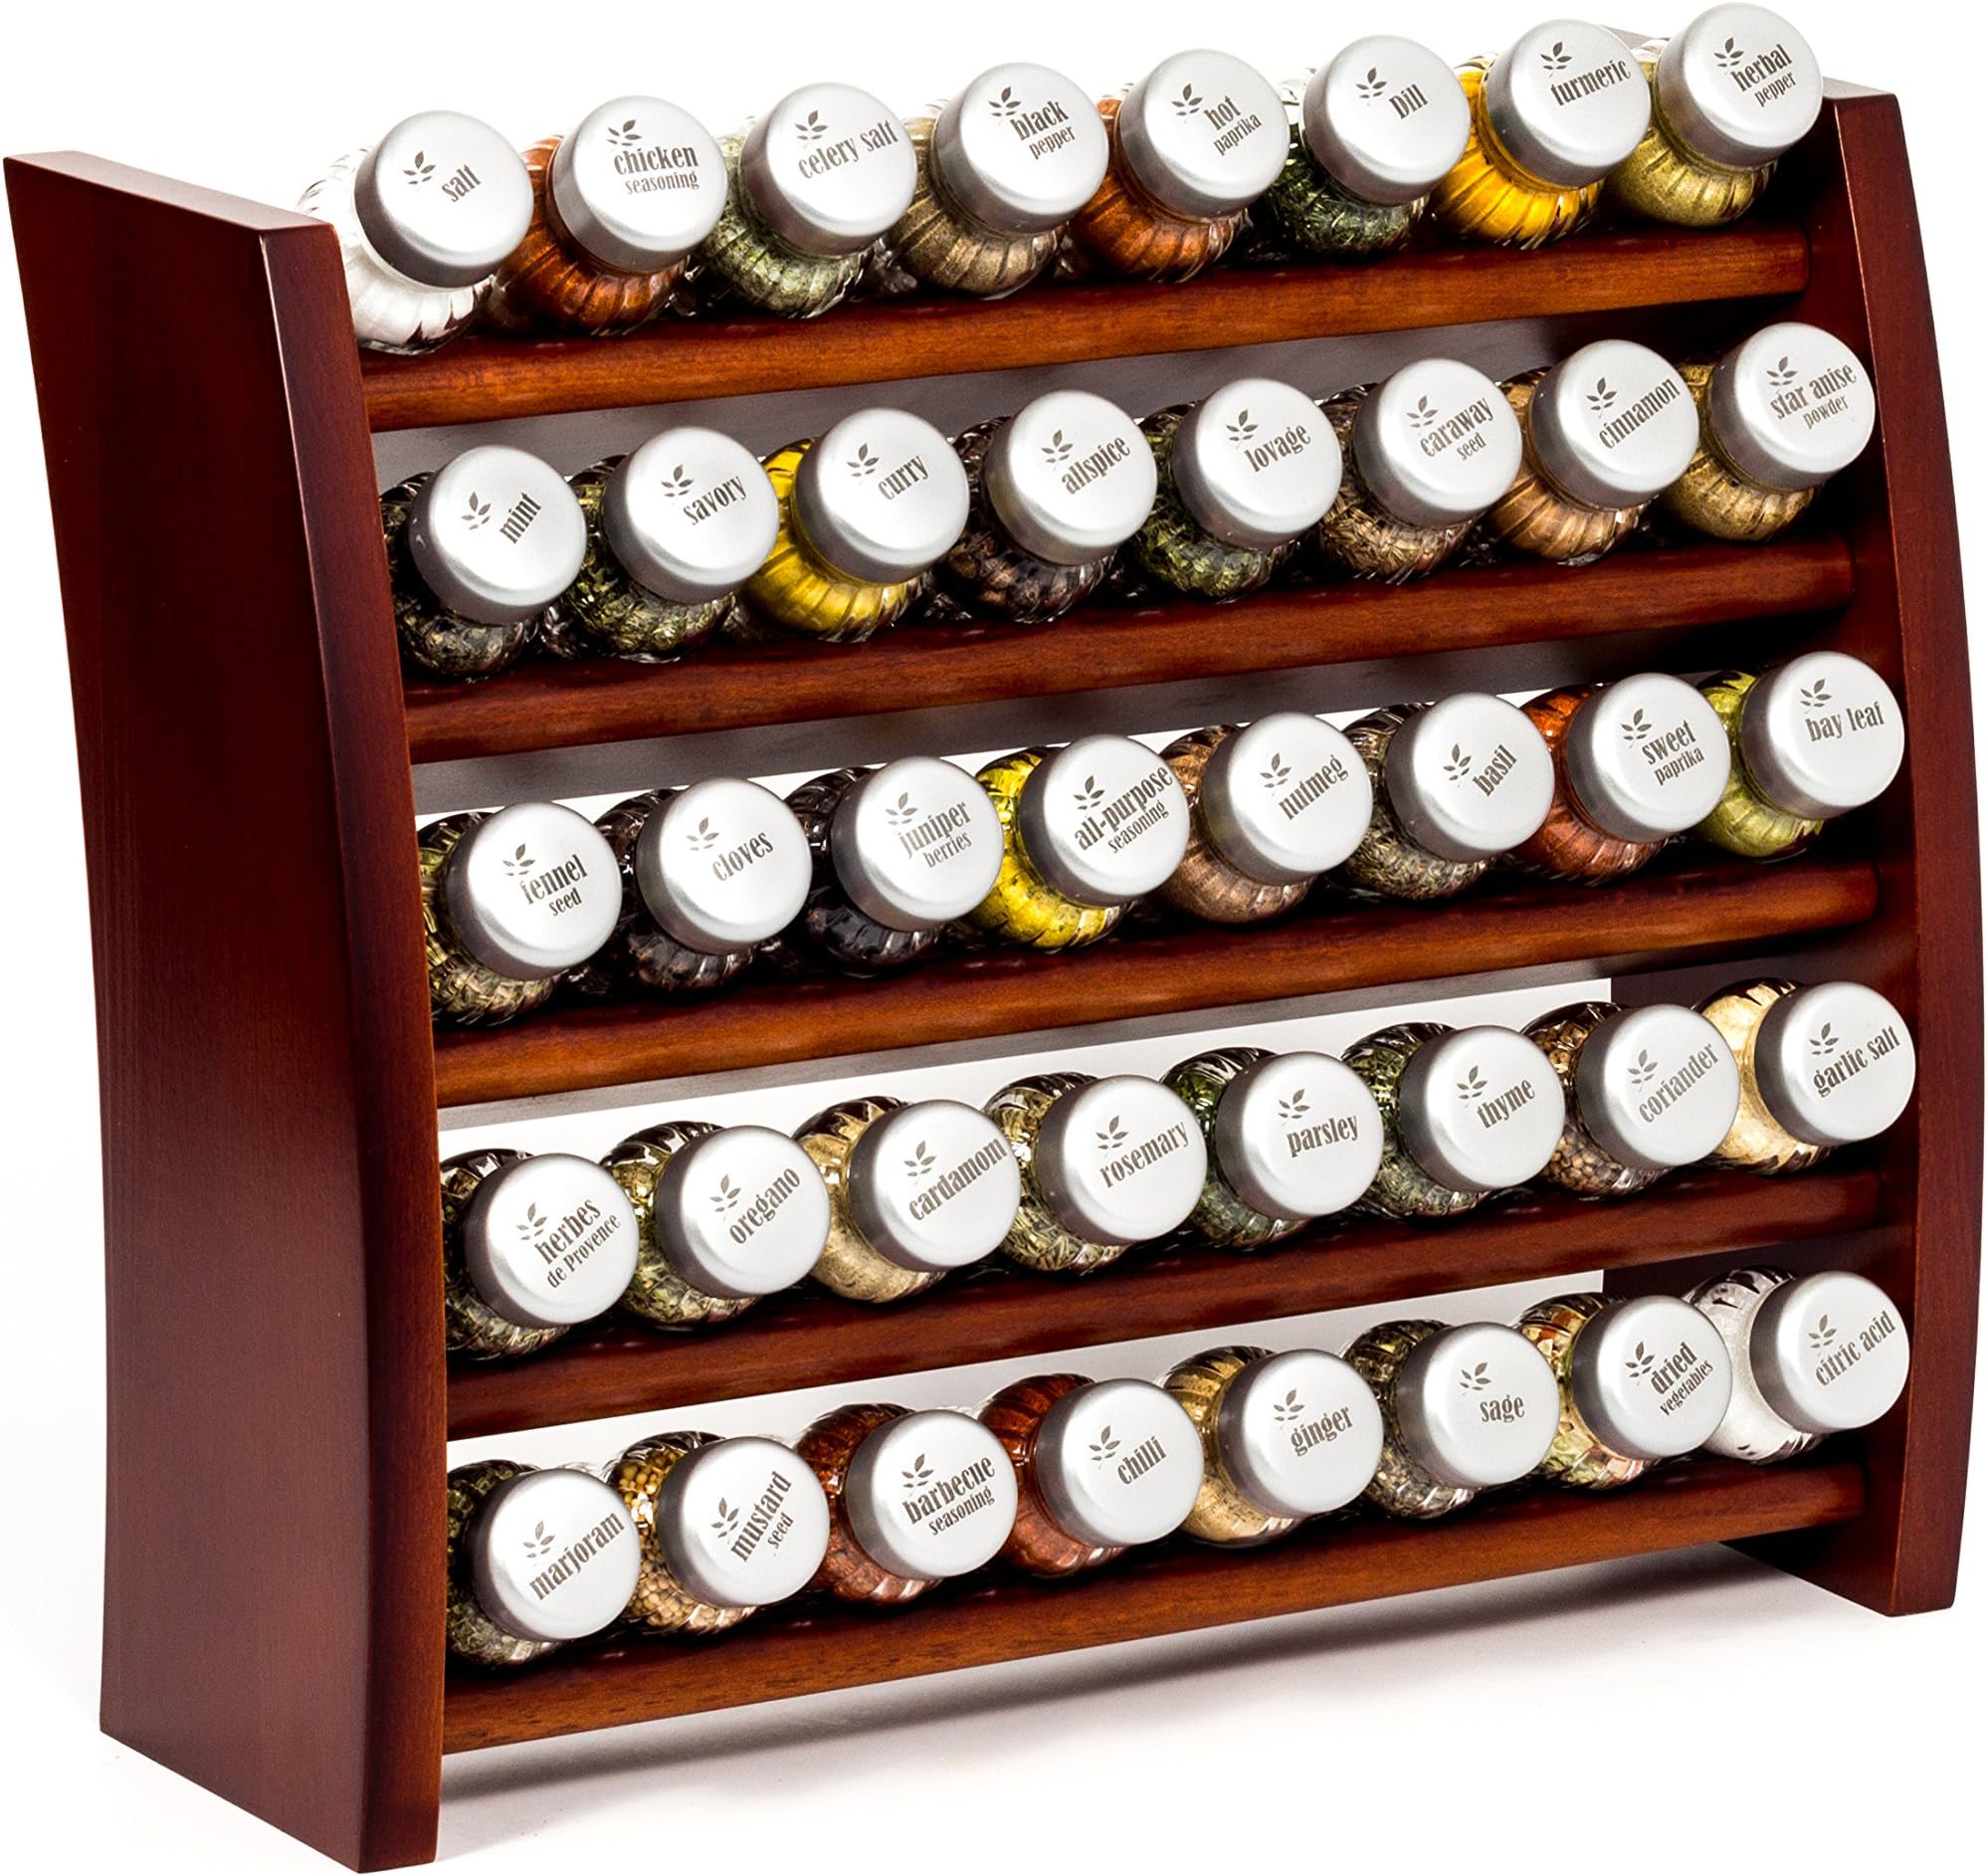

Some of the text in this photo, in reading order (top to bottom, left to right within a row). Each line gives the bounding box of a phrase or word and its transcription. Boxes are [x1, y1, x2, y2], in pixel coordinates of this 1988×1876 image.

[1550, 59, 1631, 105] turmeric
[1730, 44, 1792, 92] herbal
[1755, 73, 1796, 106] pepper
[1010, 102, 1069, 140] black
[1203, 96, 1240, 130] hot
[1214, 114, 1262, 155] paprika
[614, 146, 698, 175] chicken
[798, 120, 897, 178] celery salt
[1029, 125, 1075, 159] pepper
[442, 164, 481, 202] salt
[626, 171, 699, 194] seasoning
[1599, 379, 1680, 448] cinnamon
[1771, 365, 1857, 419] star anise
[1803, 396, 1849, 429] powder
[1245, 425, 1310, 472] lovage
[1420, 398, 1493, 456] caraway
[1457, 434, 1487, 460] seed
[879, 456, 928, 500] curry
[1062, 438, 1130, 494] allspice
[499, 492, 541, 544] mint
[684, 476, 746, 525] savory
[1643, 720, 1695, 764] sweet
[1806, 702, 1885, 741] bay leaf
[1279, 754, 1348, 820] nutmeg
[1473, 744, 1516, 796] basil
[1655, 747, 1704, 785] paprika
[898, 802, 970, 858] juniper
[1075, 767, 1173, 850] all-purpose
[1108, 800, 1169, 853] seasoning
[712, 833, 773, 881] cloves
[923, 832, 971, 868] berries
[519, 854, 587, 905] fennel
[549, 888, 581, 916] seed
[1640, 1043, 1718, 1123] coriander
[1814, 1026, 1900, 1097] garlic salt
[1477, 1080, 1535, 1129] thyme
[1100, 1123, 1189, 1188] rosemary
[1288, 1116, 1358, 1157] parsley
[909, 1139, 1007, 1220] cardamom
[729, 1168, 800, 1243] oregano
[534, 1199, 601, 1264] herbes
[547, 1214, 621, 1288] de Provence
[1651, 1342, 1696, 1394] dried
[1815, 1311, 1895, 1385] citric acid
[1481, 1394, 1524, 1423] sage
[1660, 1360, 1712, 1416] vegetables
[1291, 1407, 1352, 1456] ginger
[1117, 1436, 1166, 1484] chilli
[902, 1457, 995, 1525] barbecue
[929, 1486, 994, 1535] seasoning
[730, 1471, 791, 1562] mustard
[767, 1513, 793, 1549] seed
[529, 1513, 624, 1600] marjoram
